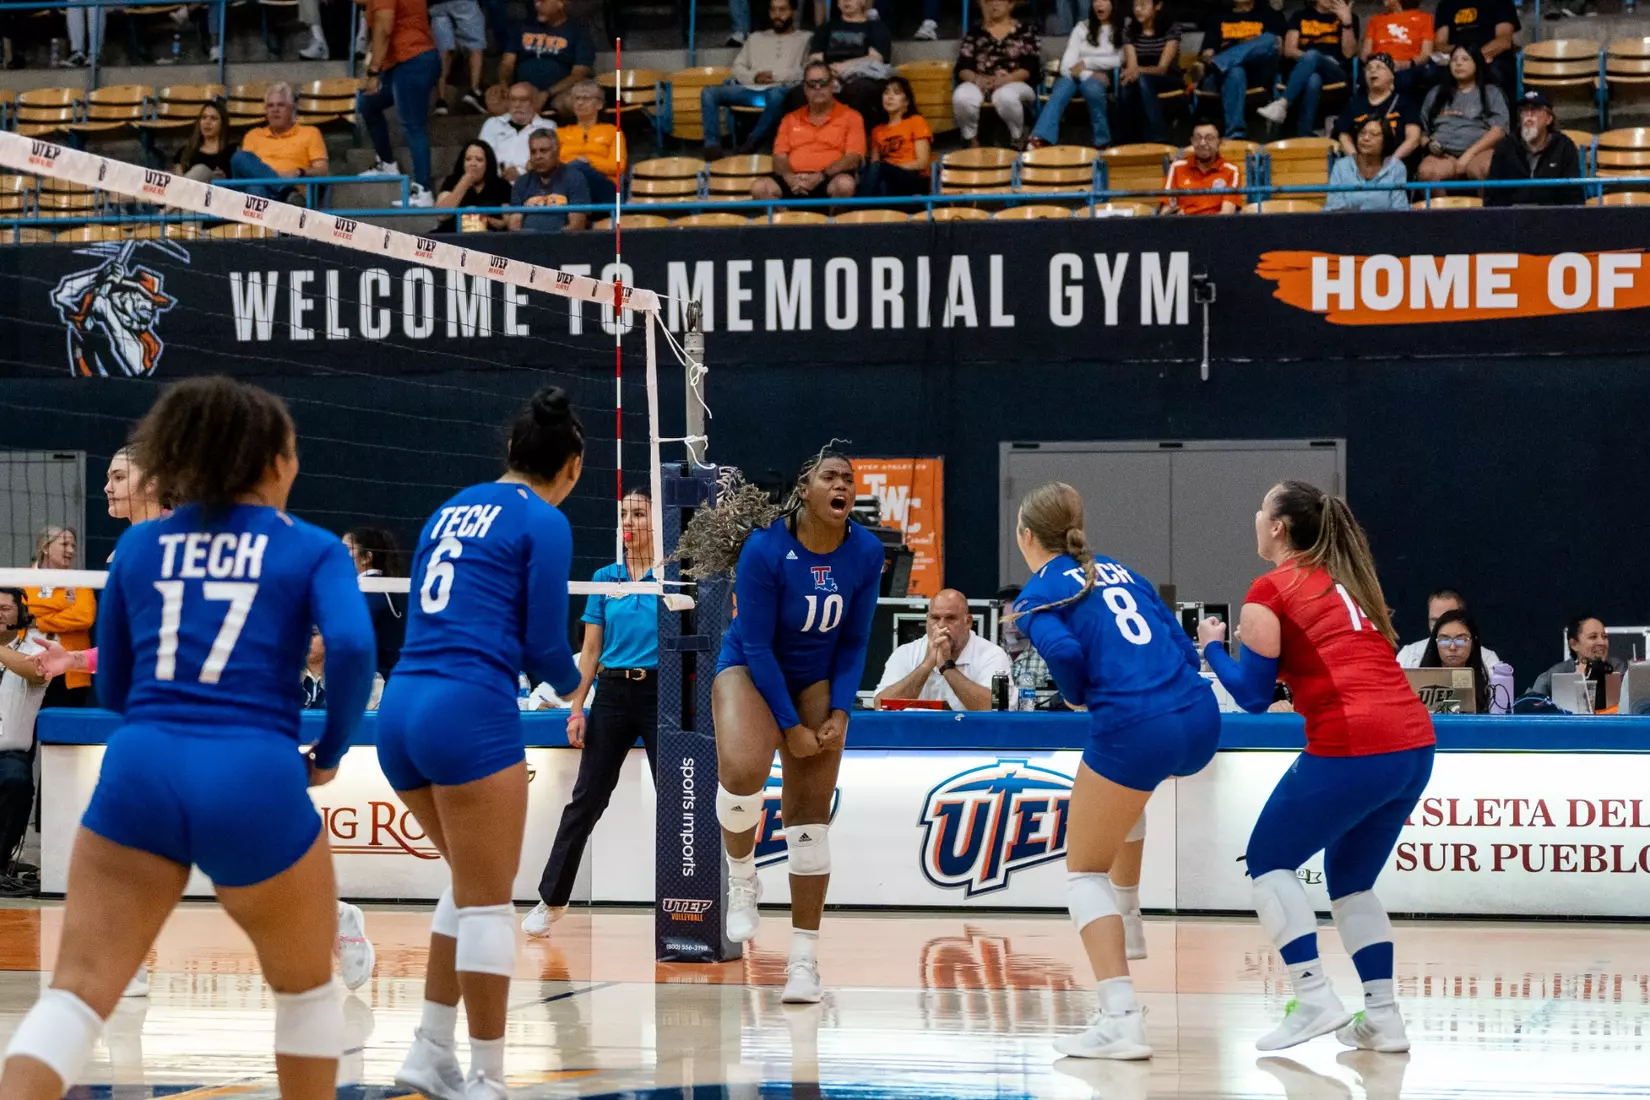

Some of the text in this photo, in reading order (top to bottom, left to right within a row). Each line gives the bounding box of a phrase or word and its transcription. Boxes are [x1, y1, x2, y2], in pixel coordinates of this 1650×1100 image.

[32, 140, 61, 160] UTEP
[145, 169, 171, 188] UTEP
[245, 195, 269, 212] UTEP
[334, 216, 358, 233] UTEP
[416, 238, 437, 252] UTEP
[490, 255, 509, 270] UTEP
[556, 271, 575, 285] UTEP
[1311, 252, 1642, 312] HOME OF
[229, 251, 1190, 341] WELCOME TO MEMORIAL GYM
[863, 473, 921, 533] TWC
[430, 504, 503, 539] TECH
[158, 531, 268, 579] TECH
[420, 536, 463, 614] 6
[800, 593, 844, 633] 10
[1102, 586, 1152, 645] 8
[153, 580, 259, 684] 17
[680, 757, 696, 877] sports imports
[1566, 798, 1650, 828] DEL
[1396, 842, 1481, 873] SUR
[663, 898, 713, 914] UTEP
[671, 912, 704, 922] VOLLEYBALL
[665, 943, 681, 951] (800)
